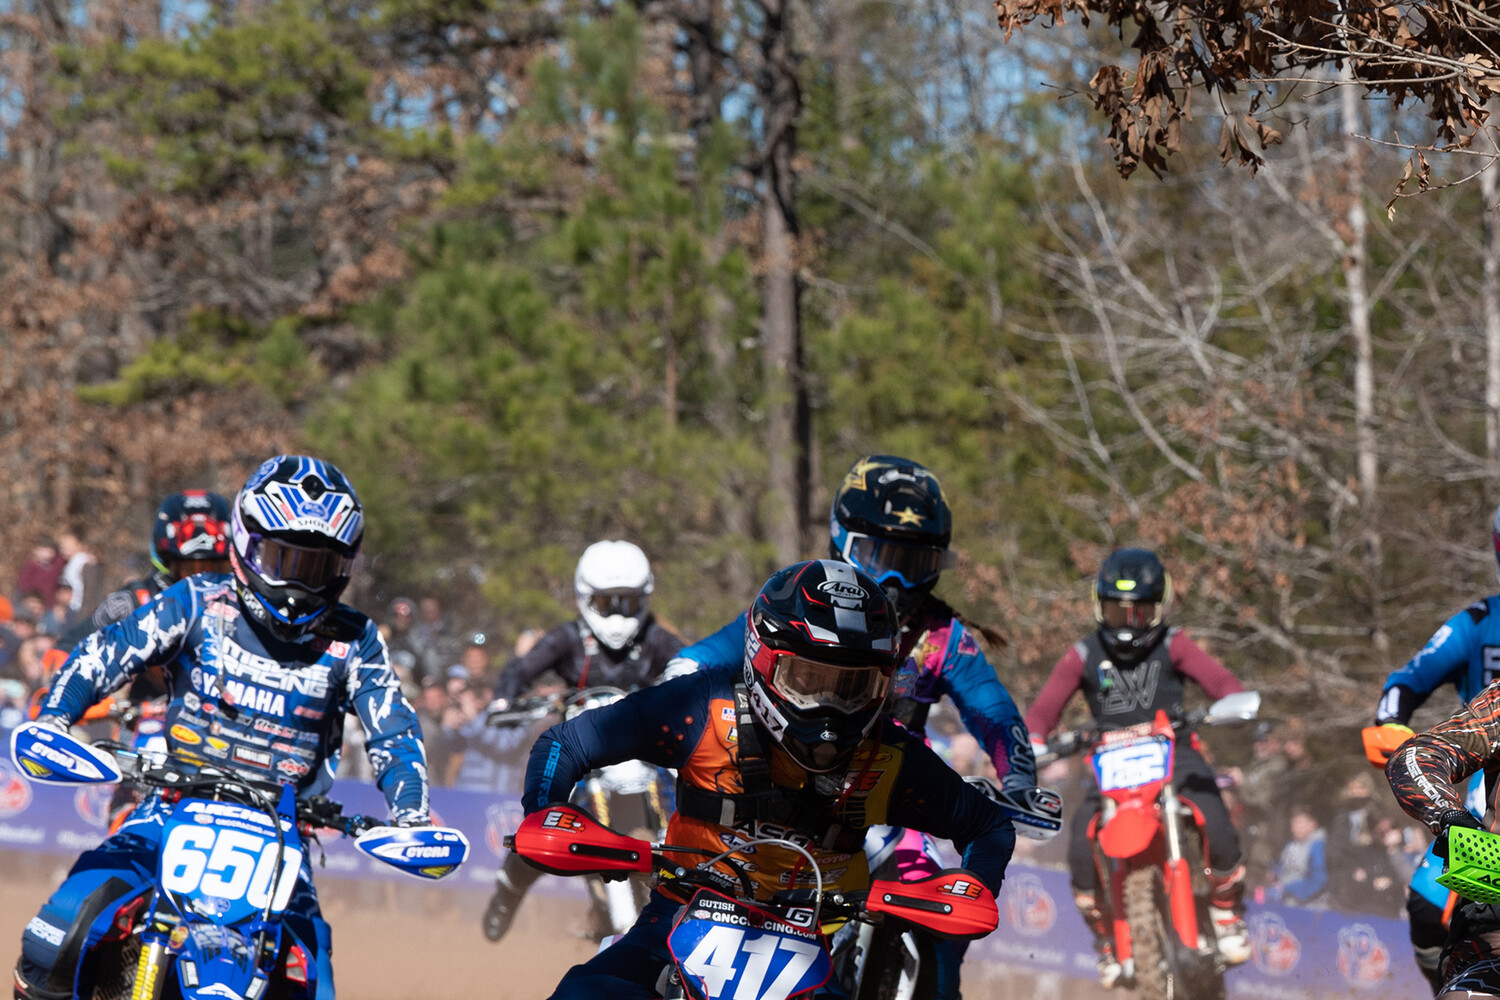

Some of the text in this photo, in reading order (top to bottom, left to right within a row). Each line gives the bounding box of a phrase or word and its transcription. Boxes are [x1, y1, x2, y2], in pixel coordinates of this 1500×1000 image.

[829, 581, 863, 598] Arai
[752, 689, 784, 733] 417
[406, 845, 451, 859] CYCRA
[161, 824, 303, 912] 650
[698, 898, 736, 912] GUTISH
